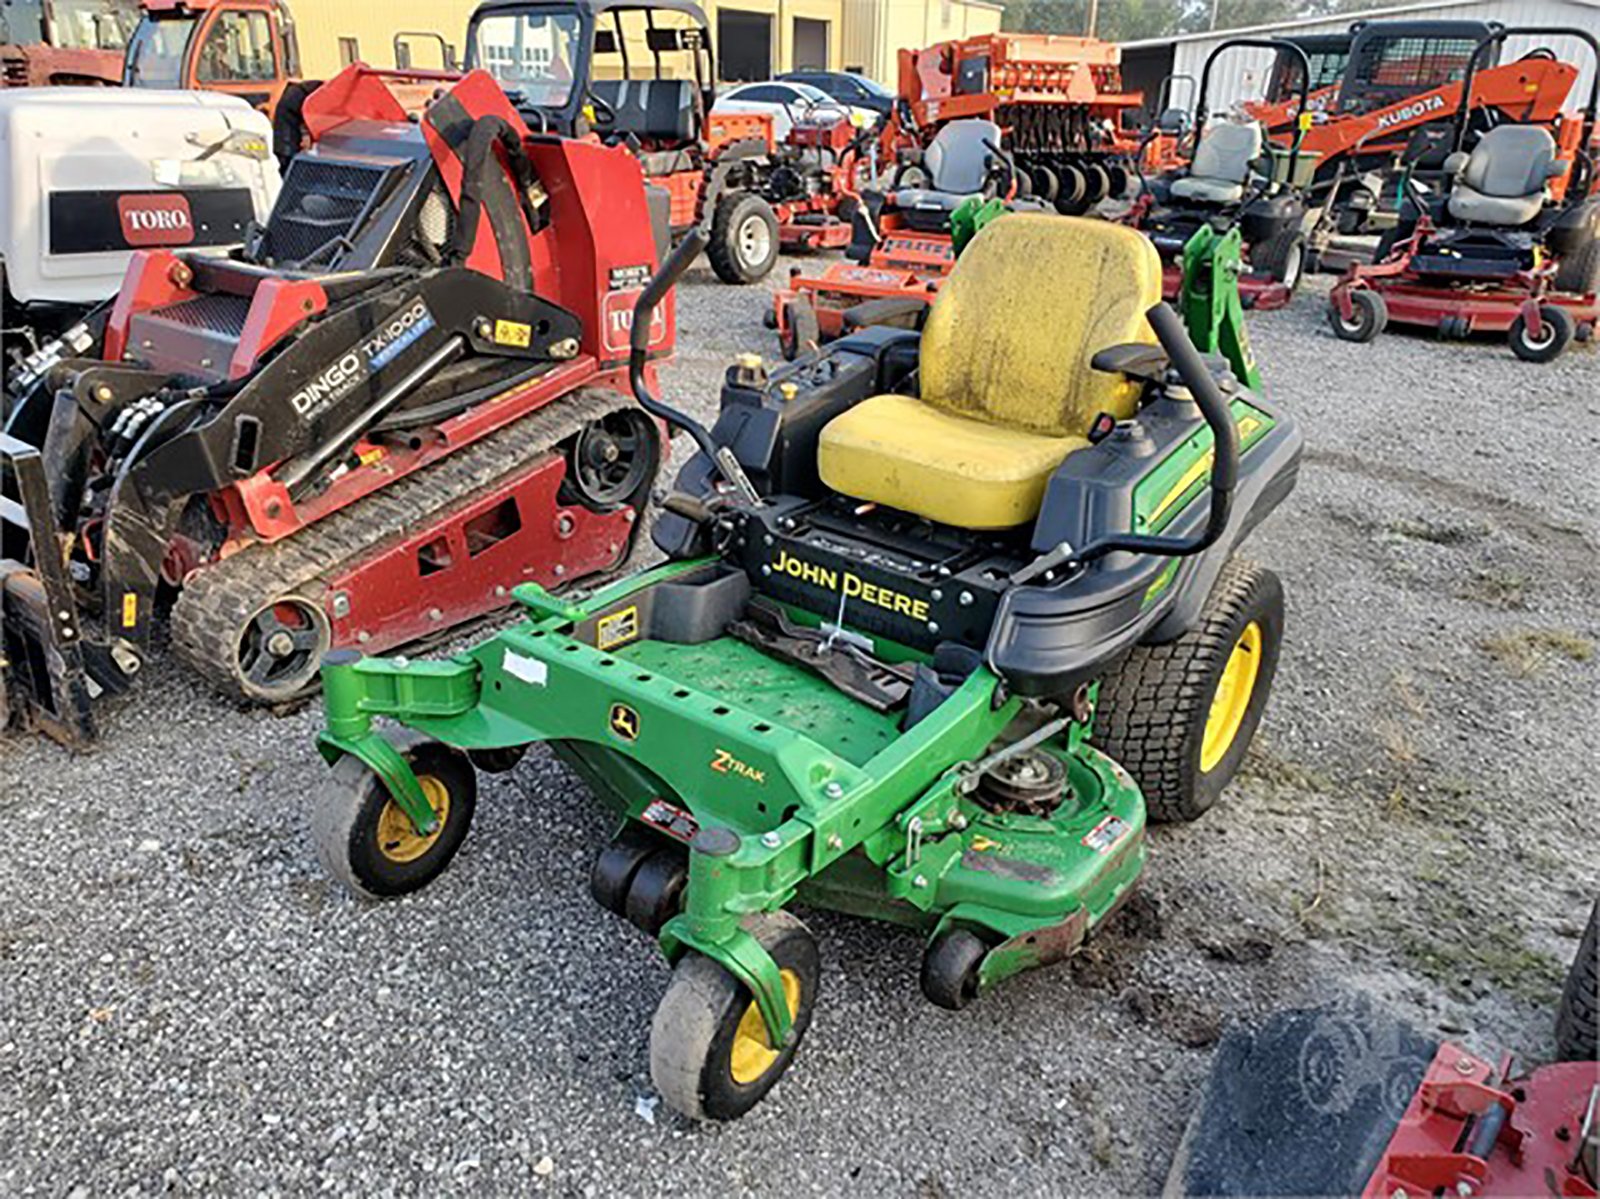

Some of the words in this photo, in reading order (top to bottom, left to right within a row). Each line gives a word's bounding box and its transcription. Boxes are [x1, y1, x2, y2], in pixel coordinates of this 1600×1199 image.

[1377, 95, 1445, 129] KUBOTA
[125, 209, 187, 229] TORO
[292, 353, 360, 414] DINGO
[772, 551, 838, 590] JOHN
[842, 572, 930, 622] DEERE
